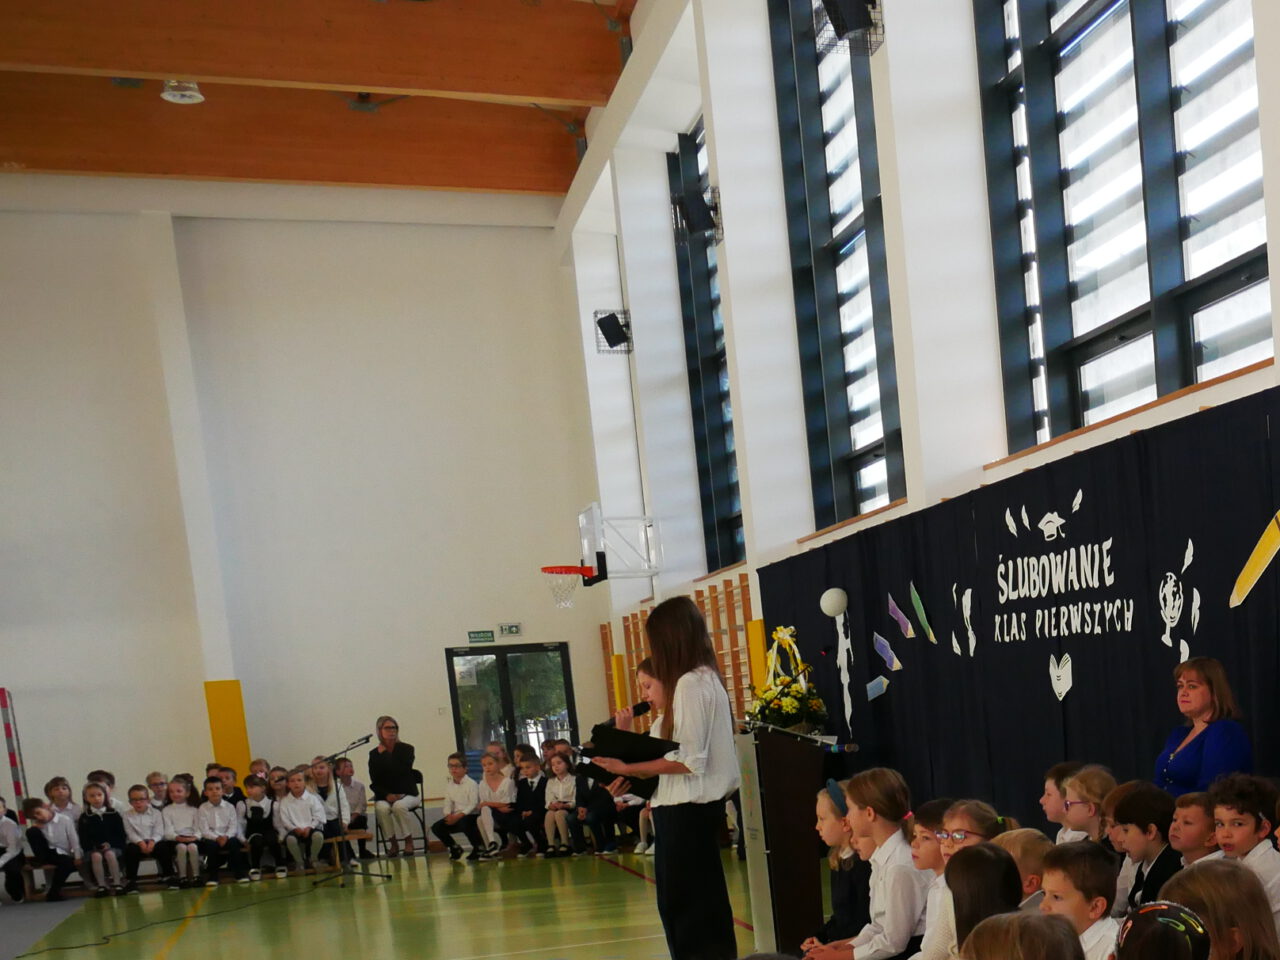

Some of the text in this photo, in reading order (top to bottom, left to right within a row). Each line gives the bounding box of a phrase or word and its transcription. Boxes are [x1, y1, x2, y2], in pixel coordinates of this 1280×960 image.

[997, 537, 1115, 604] ŚLUBOWANIE
[994, 599, 1134, 642] KLAS PIERWSZYCH
